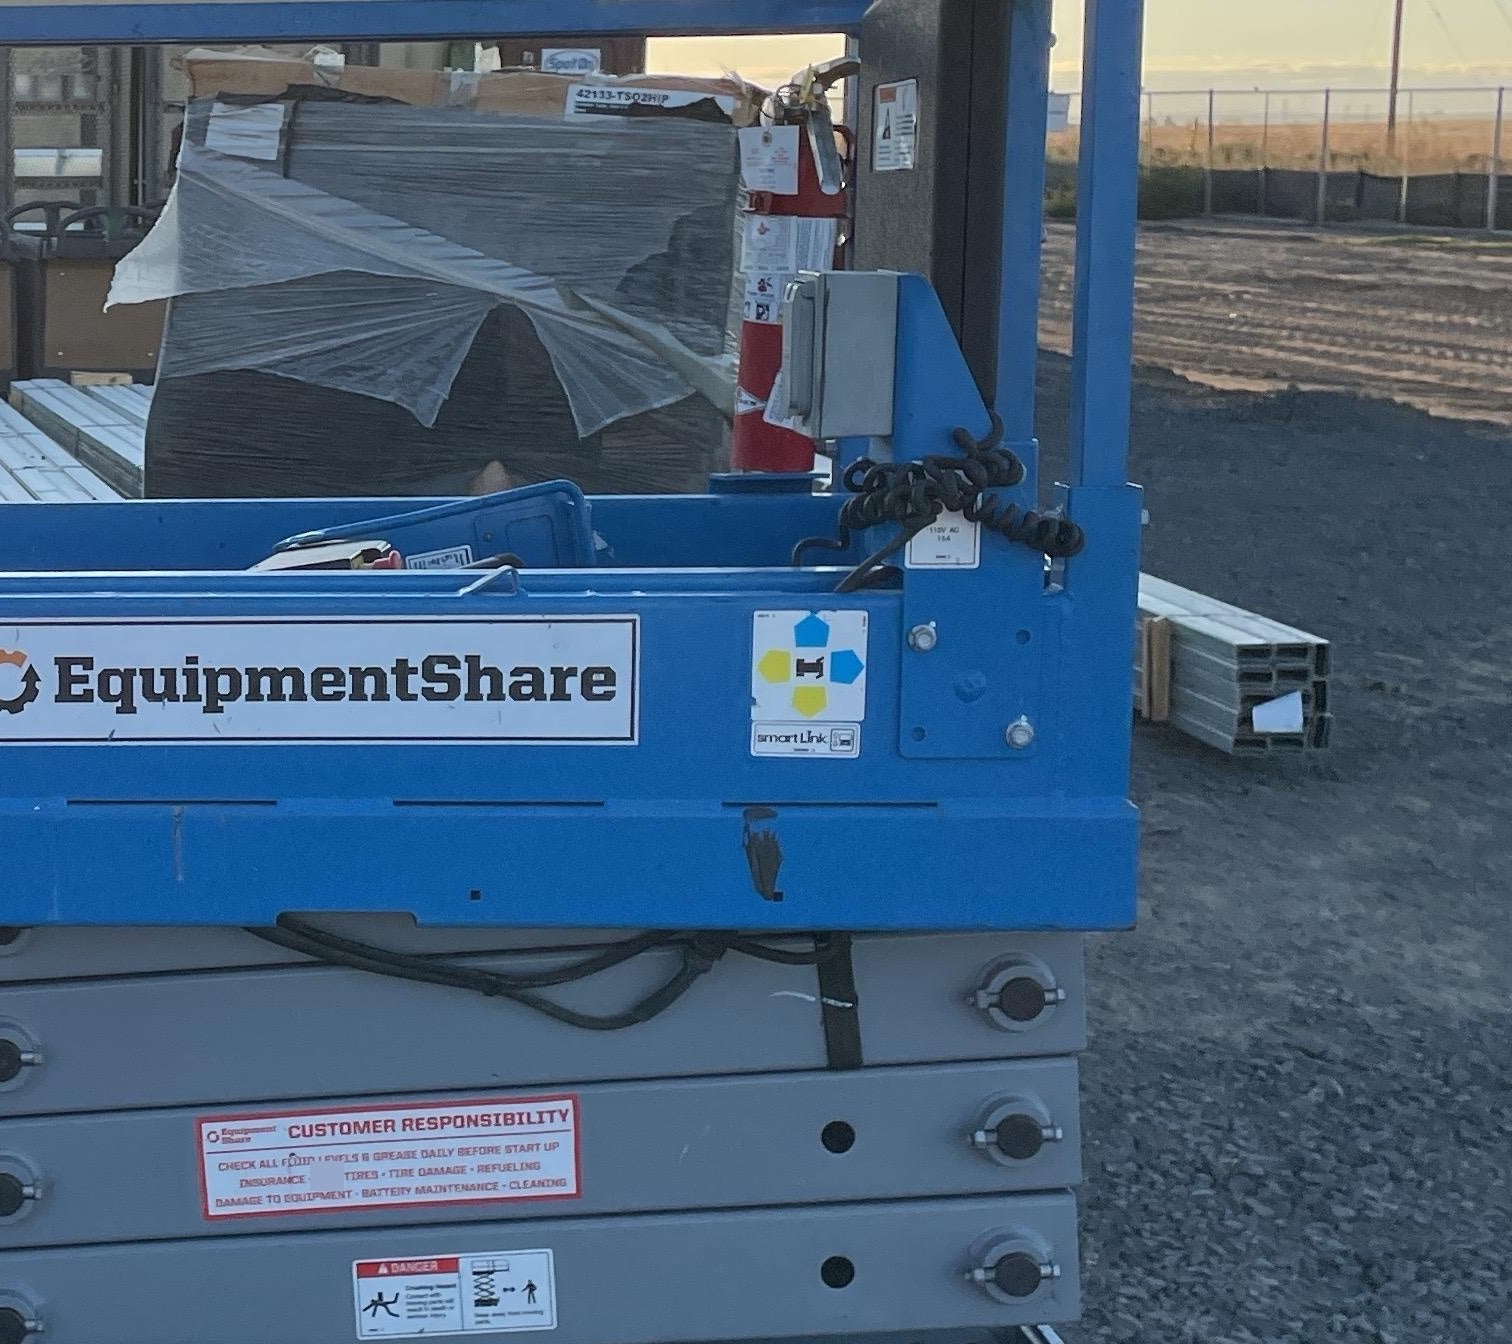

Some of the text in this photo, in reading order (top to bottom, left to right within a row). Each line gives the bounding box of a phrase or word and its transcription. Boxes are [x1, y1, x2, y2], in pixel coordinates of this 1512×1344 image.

[53, 655, 617, 714] EquipmentShare
[757, 732, 797, 744] smart
[221, 1125, 276, 1136] Equipment
[288, 1108, 570, 1139] CUSTOMER RESPONSIBILITY
[221, 1136, 252, 1145] Share
[218, 1159, 256, 1172] CHECK
[259, 1158, 278, 1169] ALL
[373, 1149, 418, 1162] GREASE
[421, 1147, 454, 1159] DAILY
[457, 1144, 501, 1157] BEFORE
[505, 1141, 541, 1154] START
[544, 1141, 560, 1151] UP
[239, 1161, 541, 1188] INSURANCE TIRES TIRE DAMAGE REFUELING
[215, 1177, 567, 1208] DAMAGE TO EQUIPMENT BATTERY MAINTENANCE CLEANING
[390, 1260, 438, 1273] DANGER
